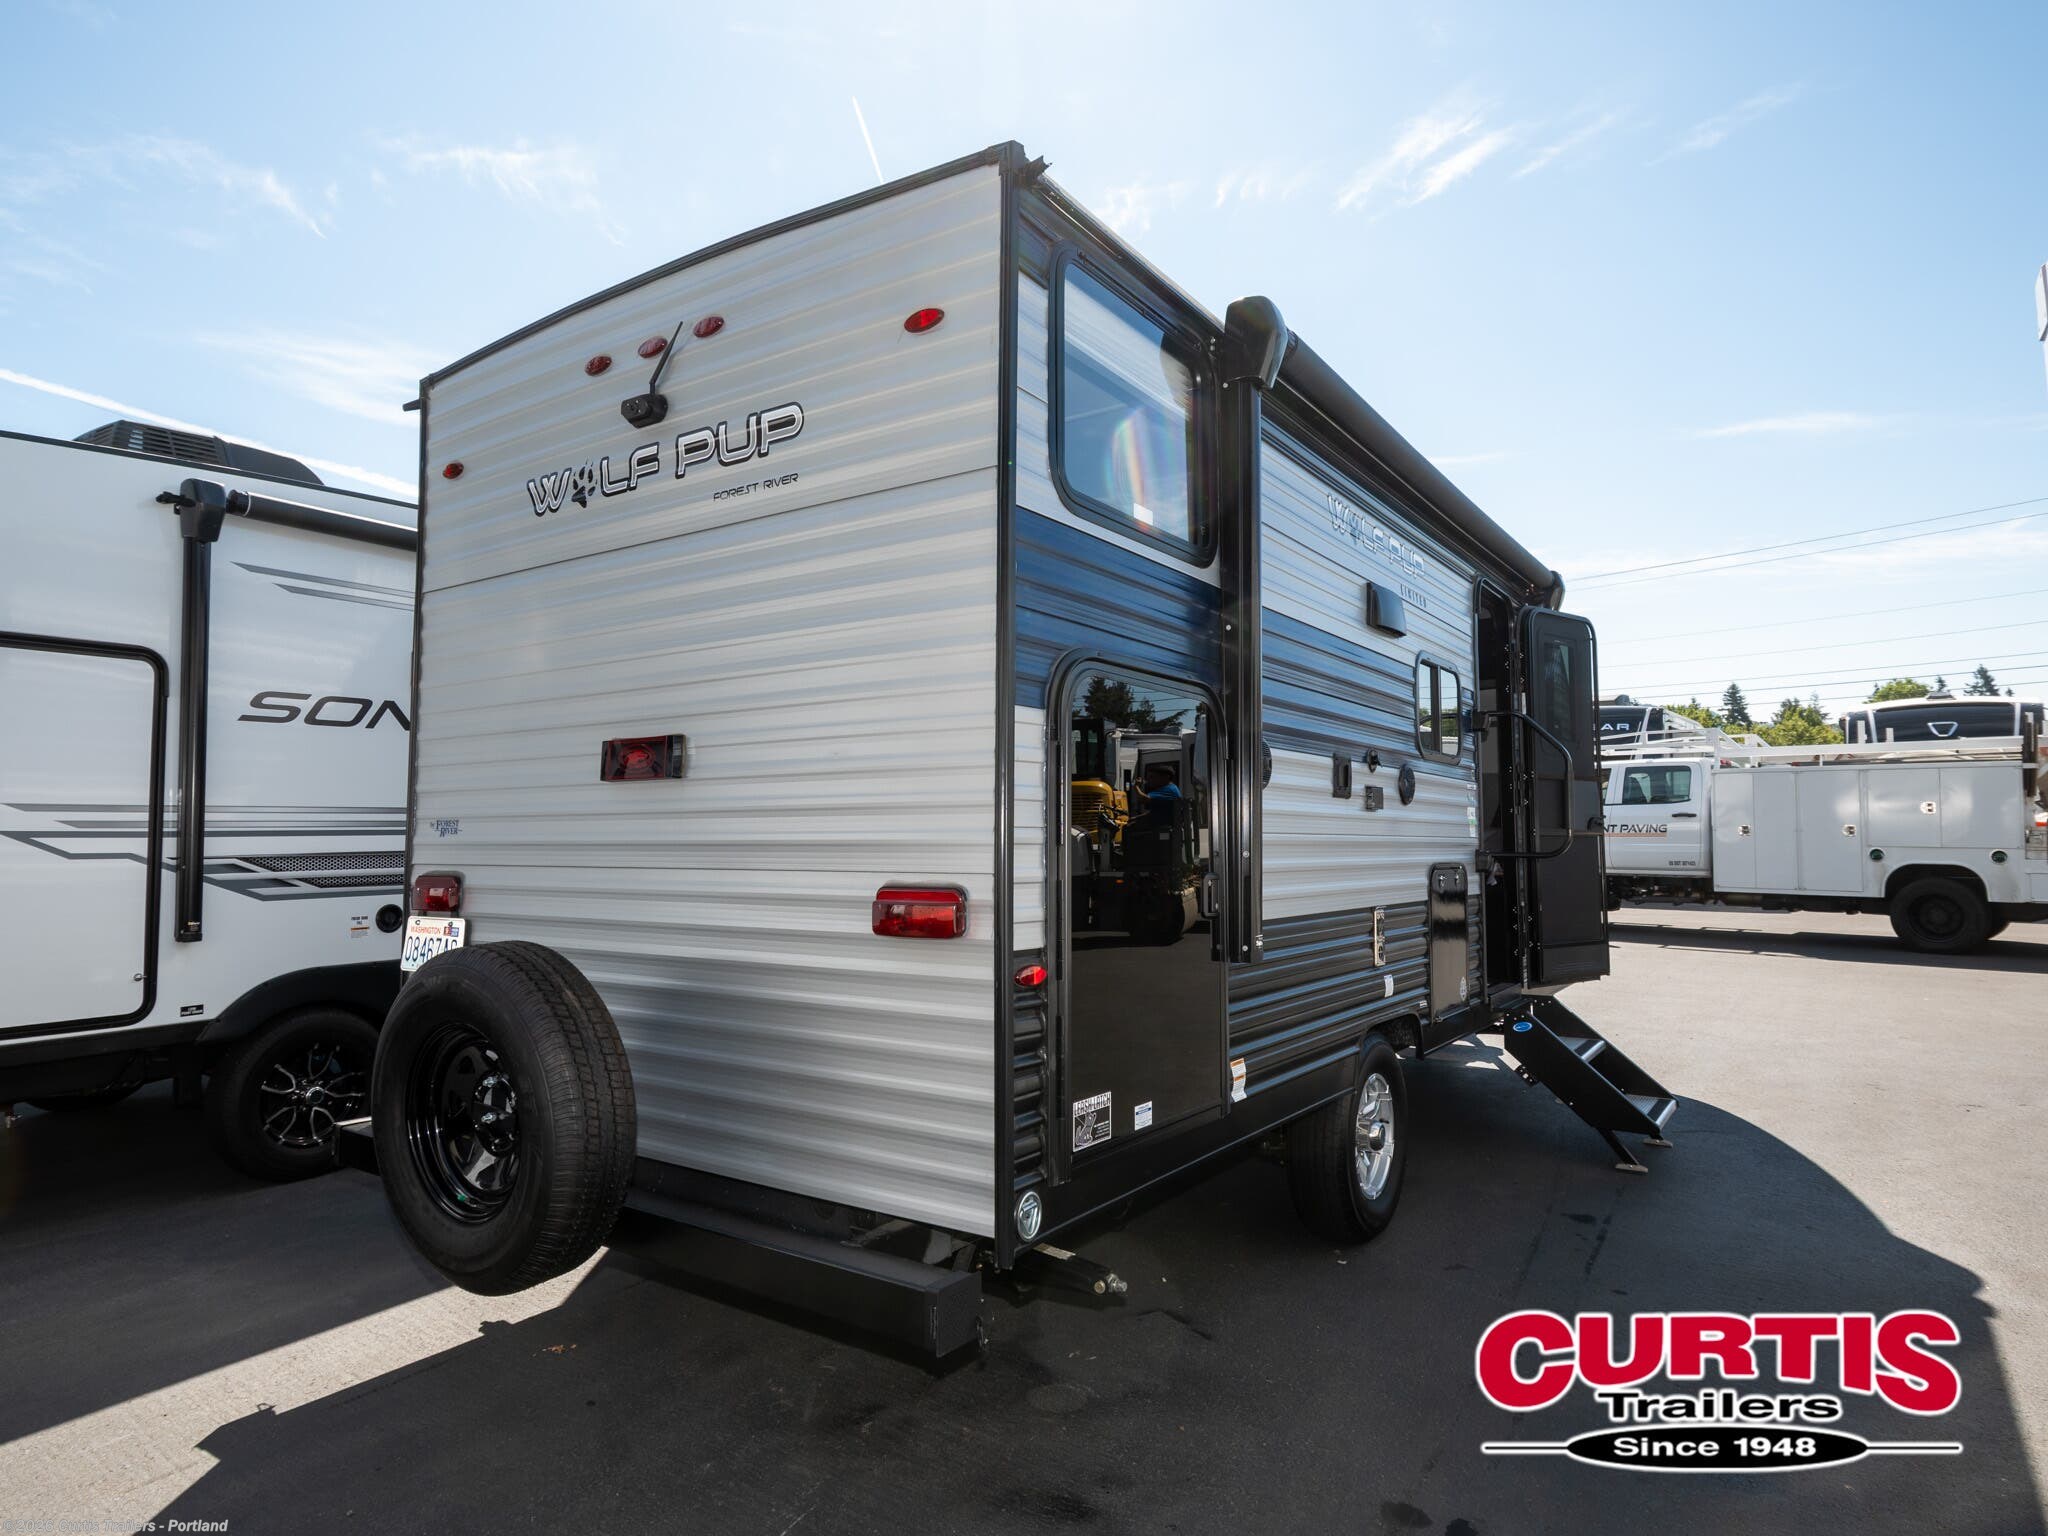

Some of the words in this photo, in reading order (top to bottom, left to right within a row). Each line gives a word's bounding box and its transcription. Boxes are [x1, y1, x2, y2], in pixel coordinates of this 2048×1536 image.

[675, 401, 804, 479] PUP
[713, 482, 759, 501] FOREST
[763, 473, 799, 490] RIVER
[1620, 824, 1668, 833] PAVING
